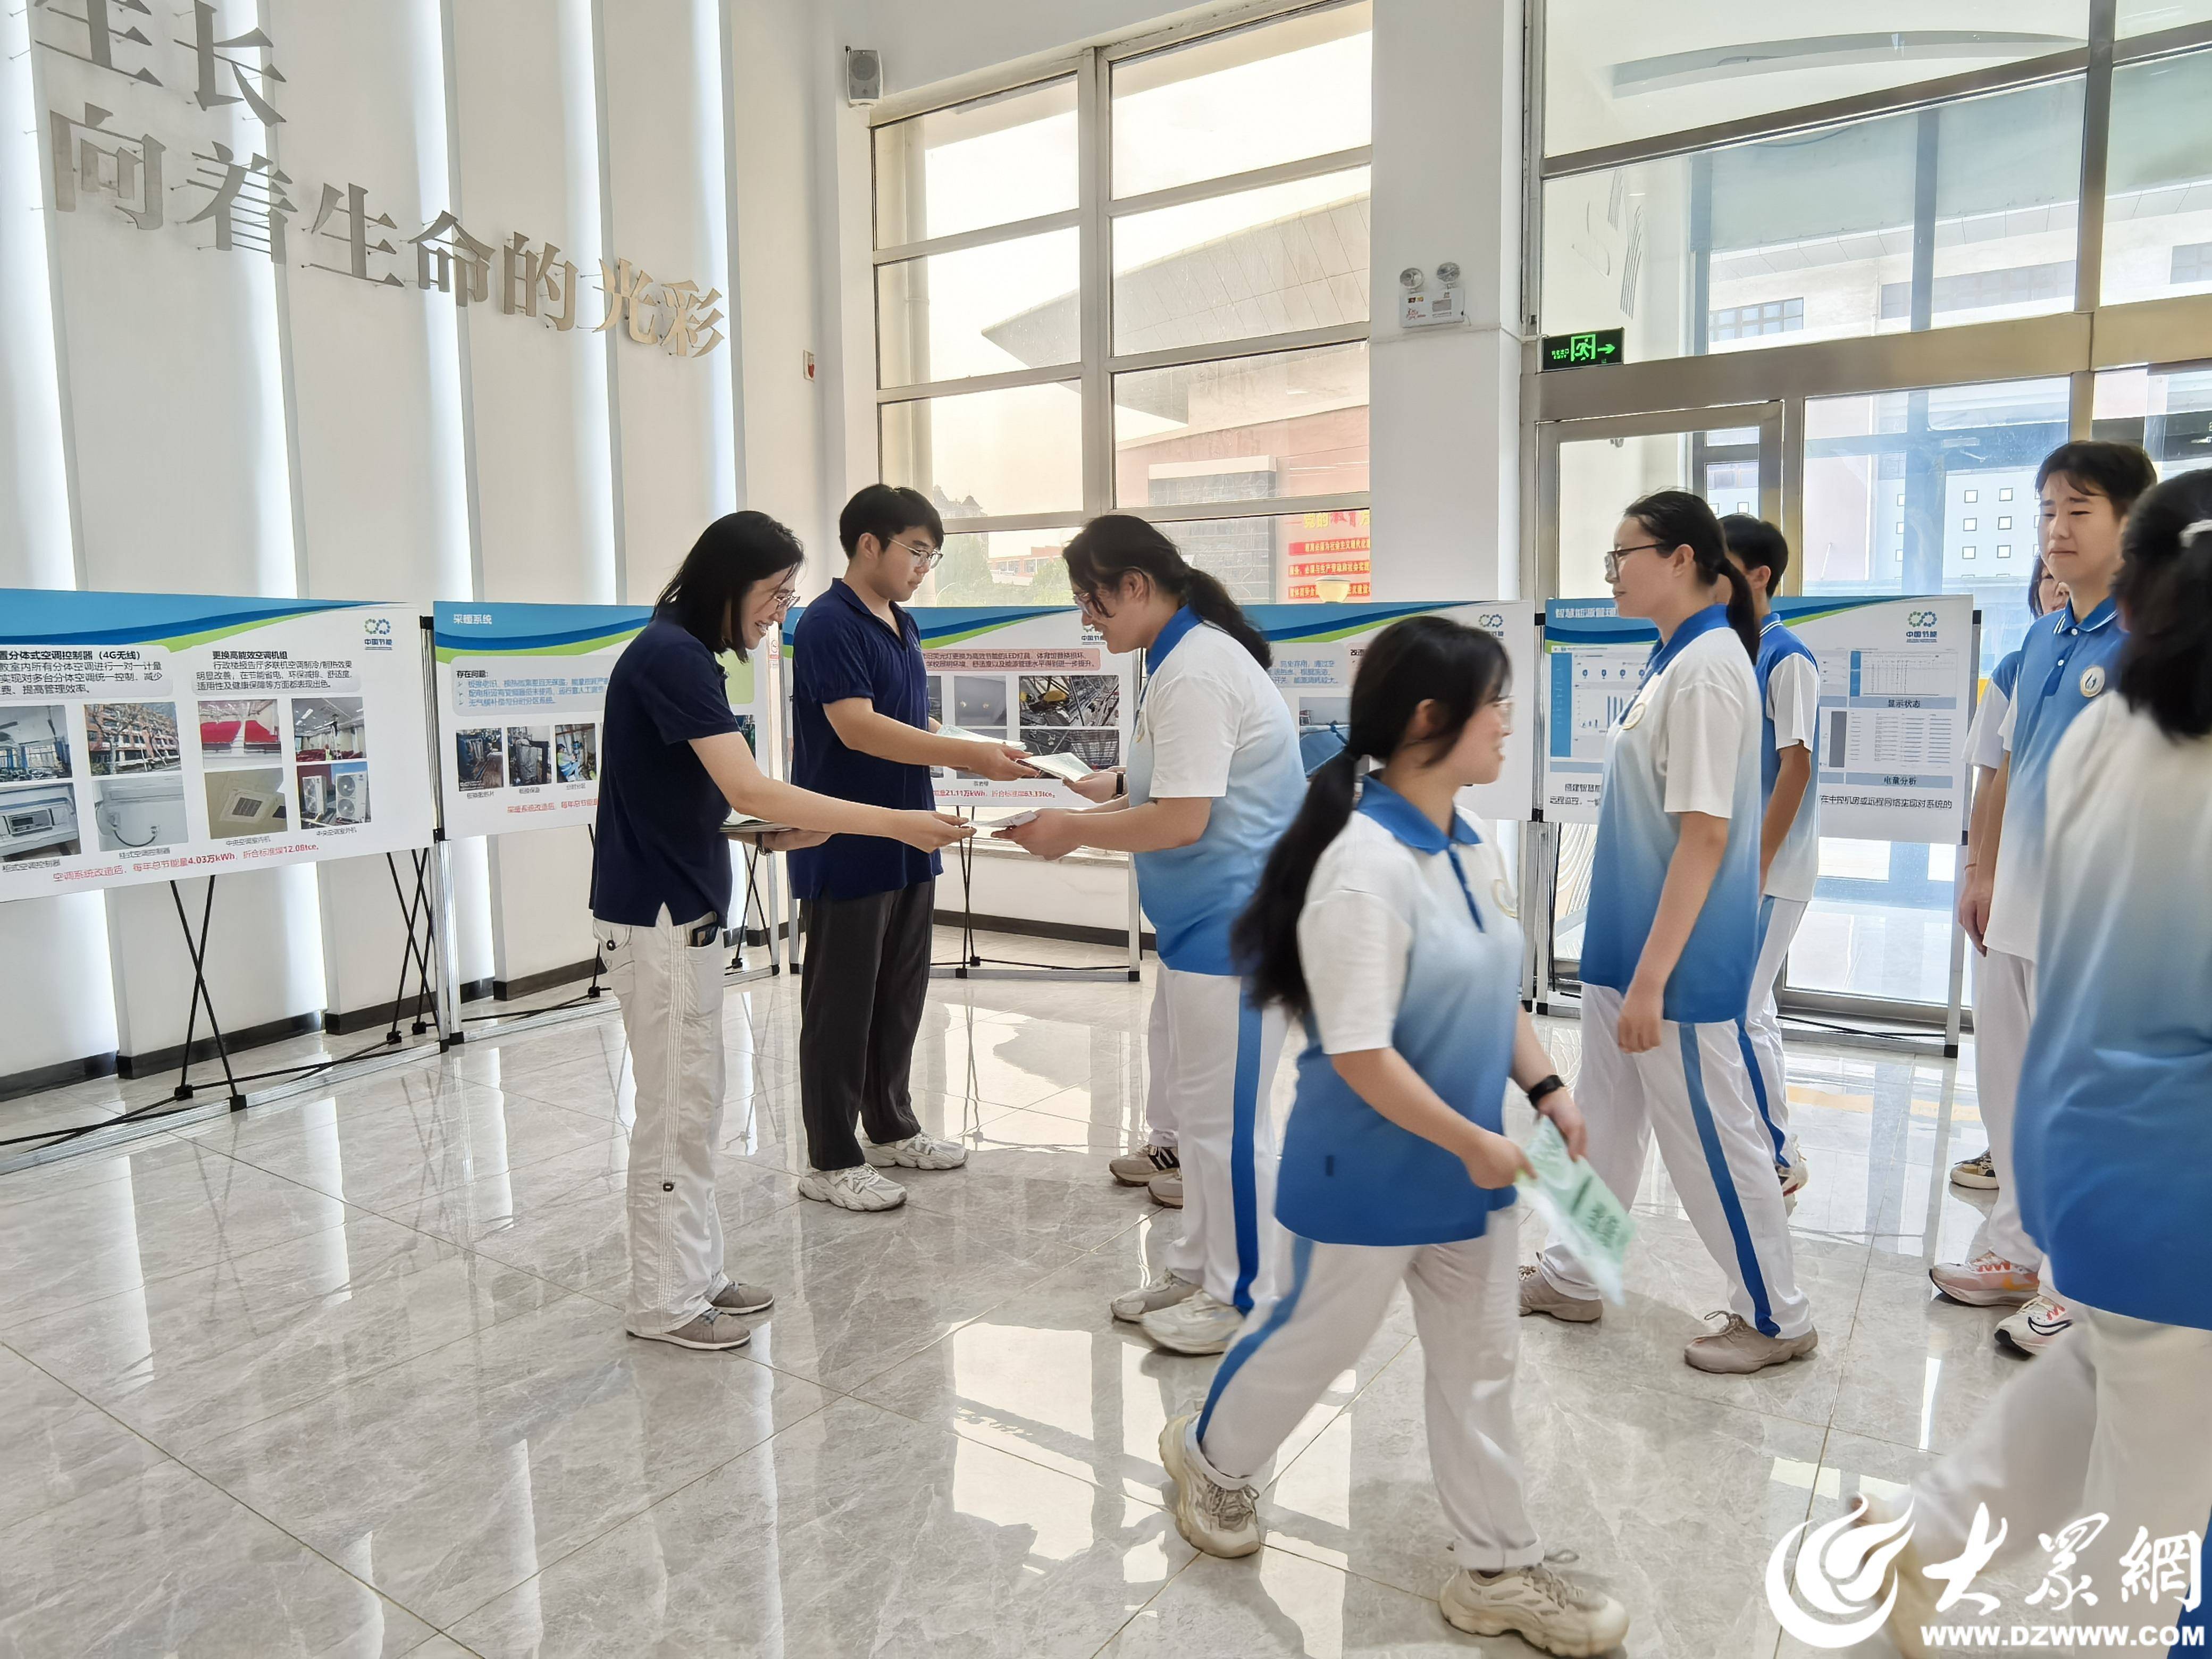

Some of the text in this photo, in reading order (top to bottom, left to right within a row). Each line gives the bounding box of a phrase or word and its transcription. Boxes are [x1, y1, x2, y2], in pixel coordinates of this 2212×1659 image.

[49, 101, 724, 357] 向着生命的光彩
[453, 614, 492, 625] 采暖系统
[212, 650, 288, 659] 更换高能效空调机组
[1888, 699, 1921, 708] 显示状态
[1884, 775, 1917, 785] 电量分析
